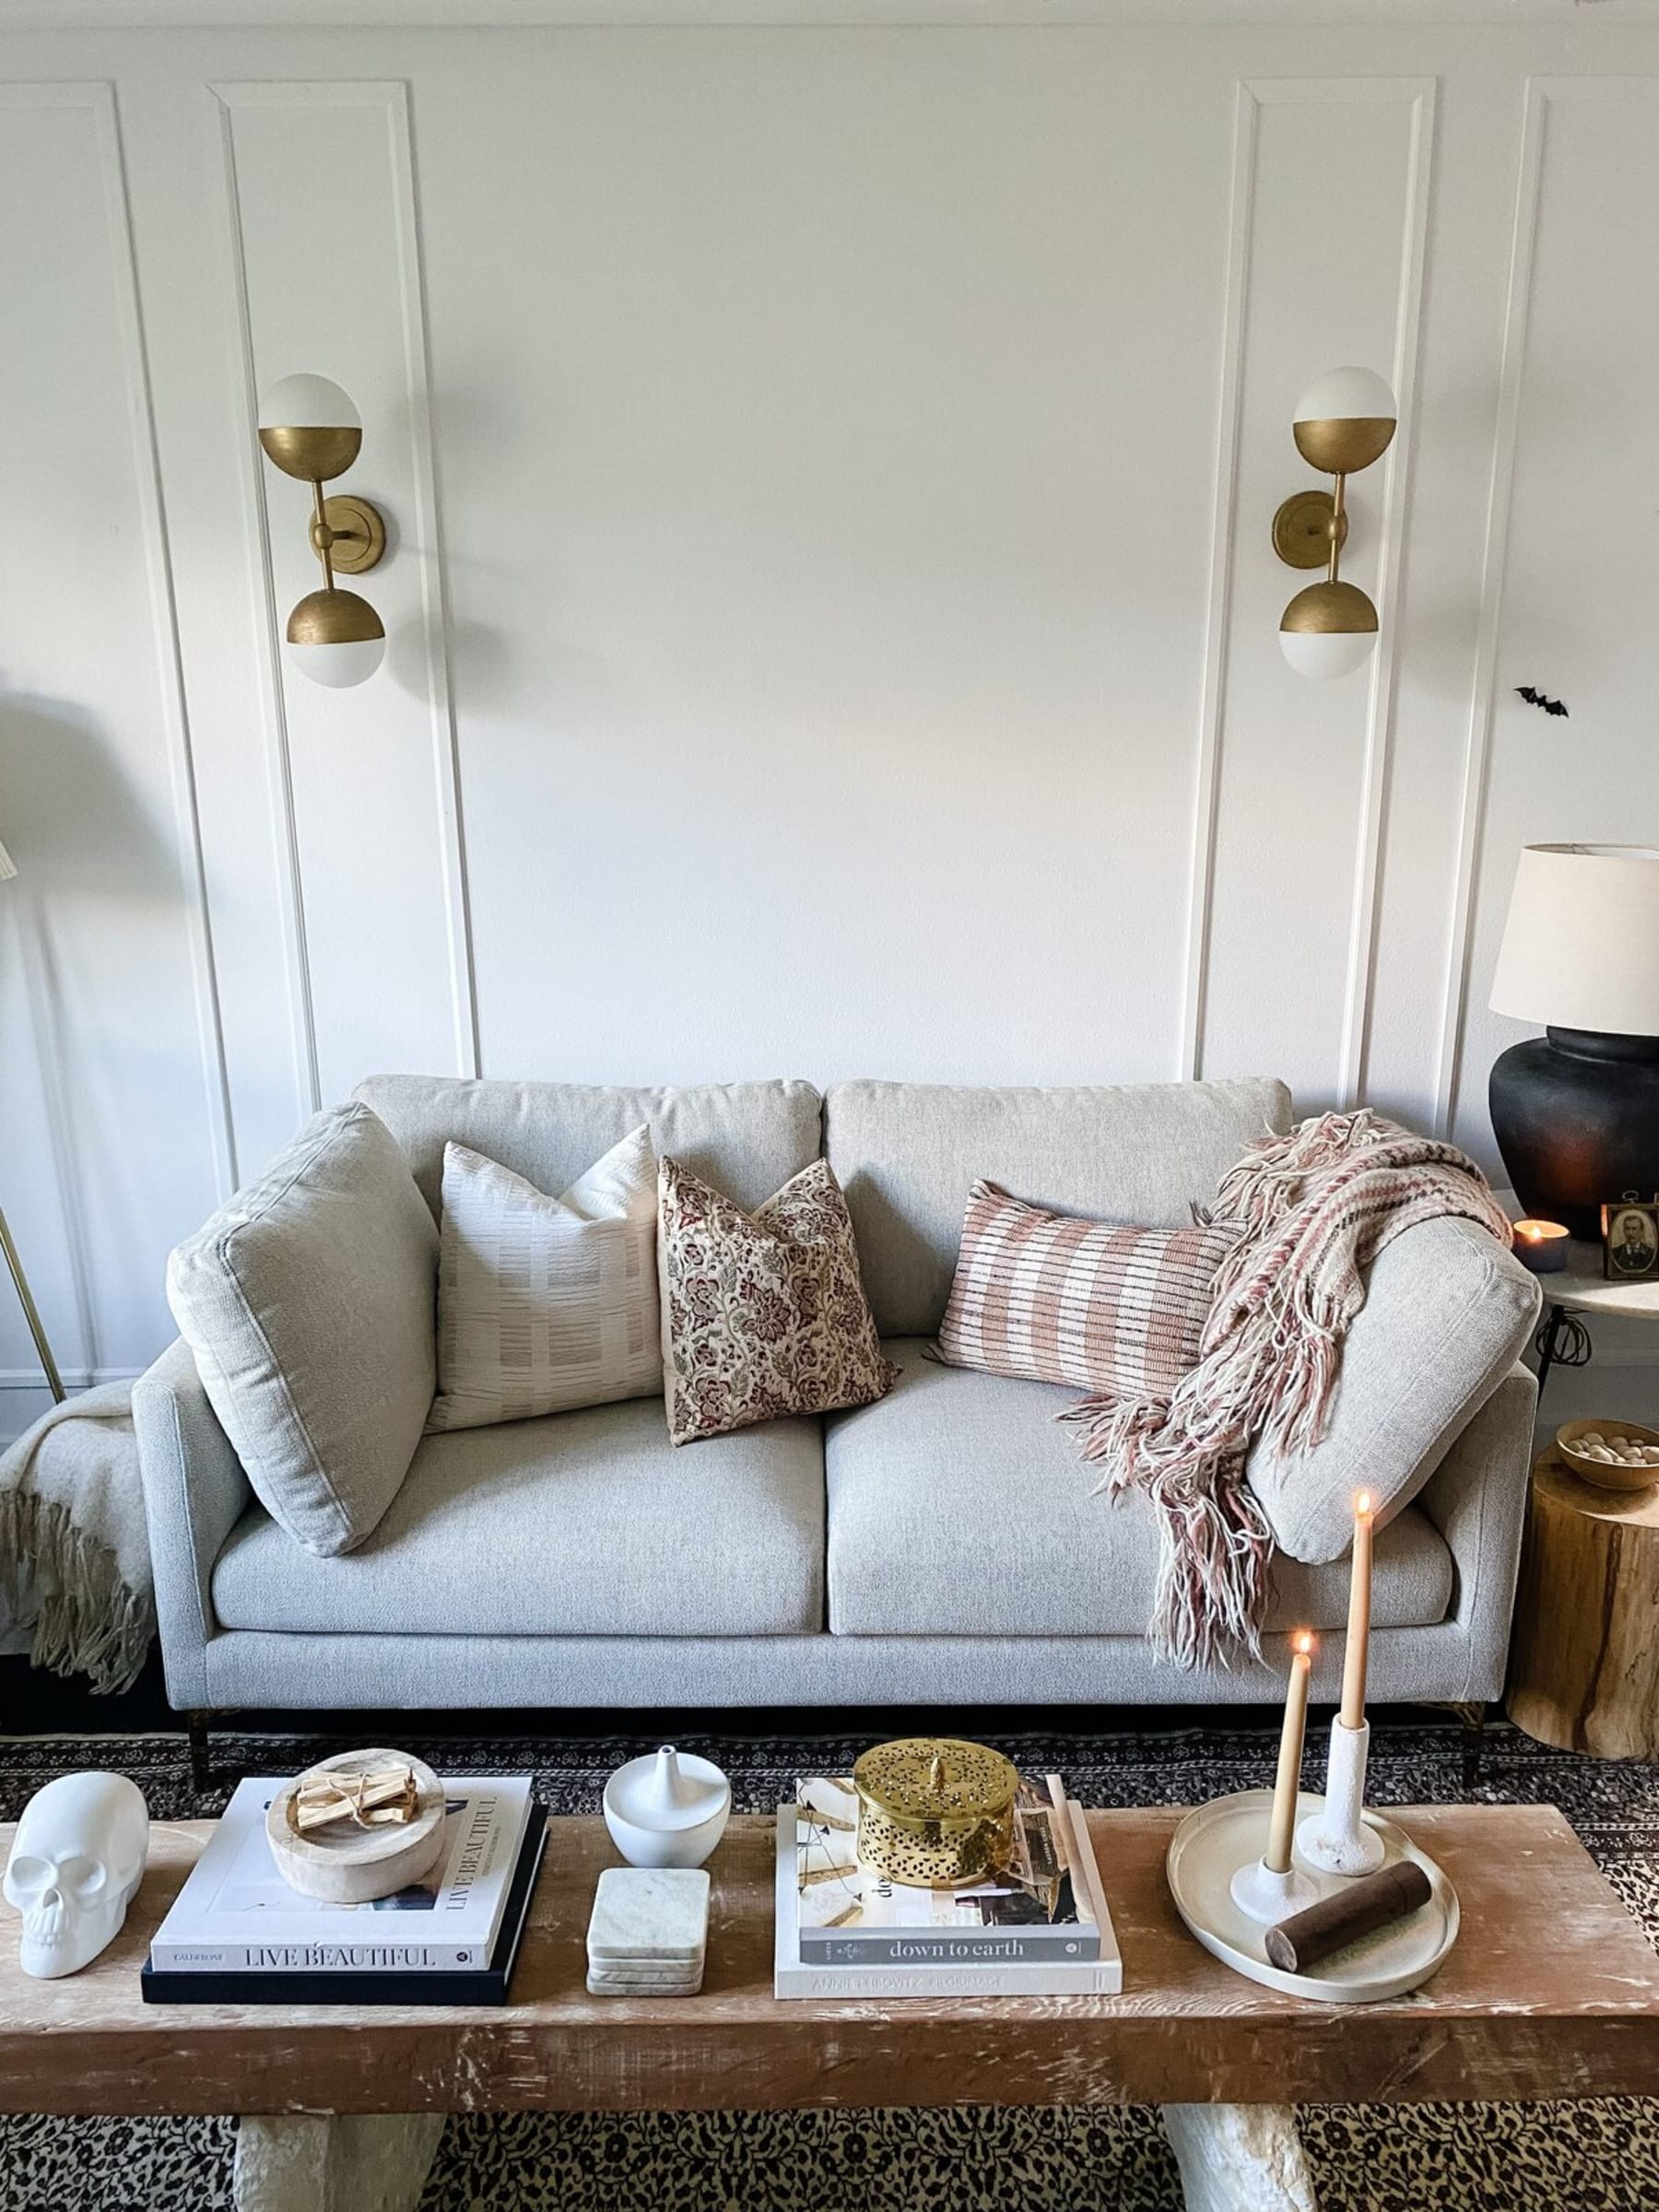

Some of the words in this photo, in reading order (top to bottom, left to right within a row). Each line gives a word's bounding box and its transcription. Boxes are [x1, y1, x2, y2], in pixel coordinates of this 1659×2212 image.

[459, 1796, 498, 1873] BEAUTIFUL
[446, 1877, 474, 1911] LIVE
[871, 1877, 892, 1898] do
[245, 1950, 297, 1966] LIVE
[305, 1948, 436, 1966] BEAUTIFUL
[889, 1941, 944, 1957] down
[949, 1943, 968, 1956] to
[972, 1939, 1024, 1956] earth
